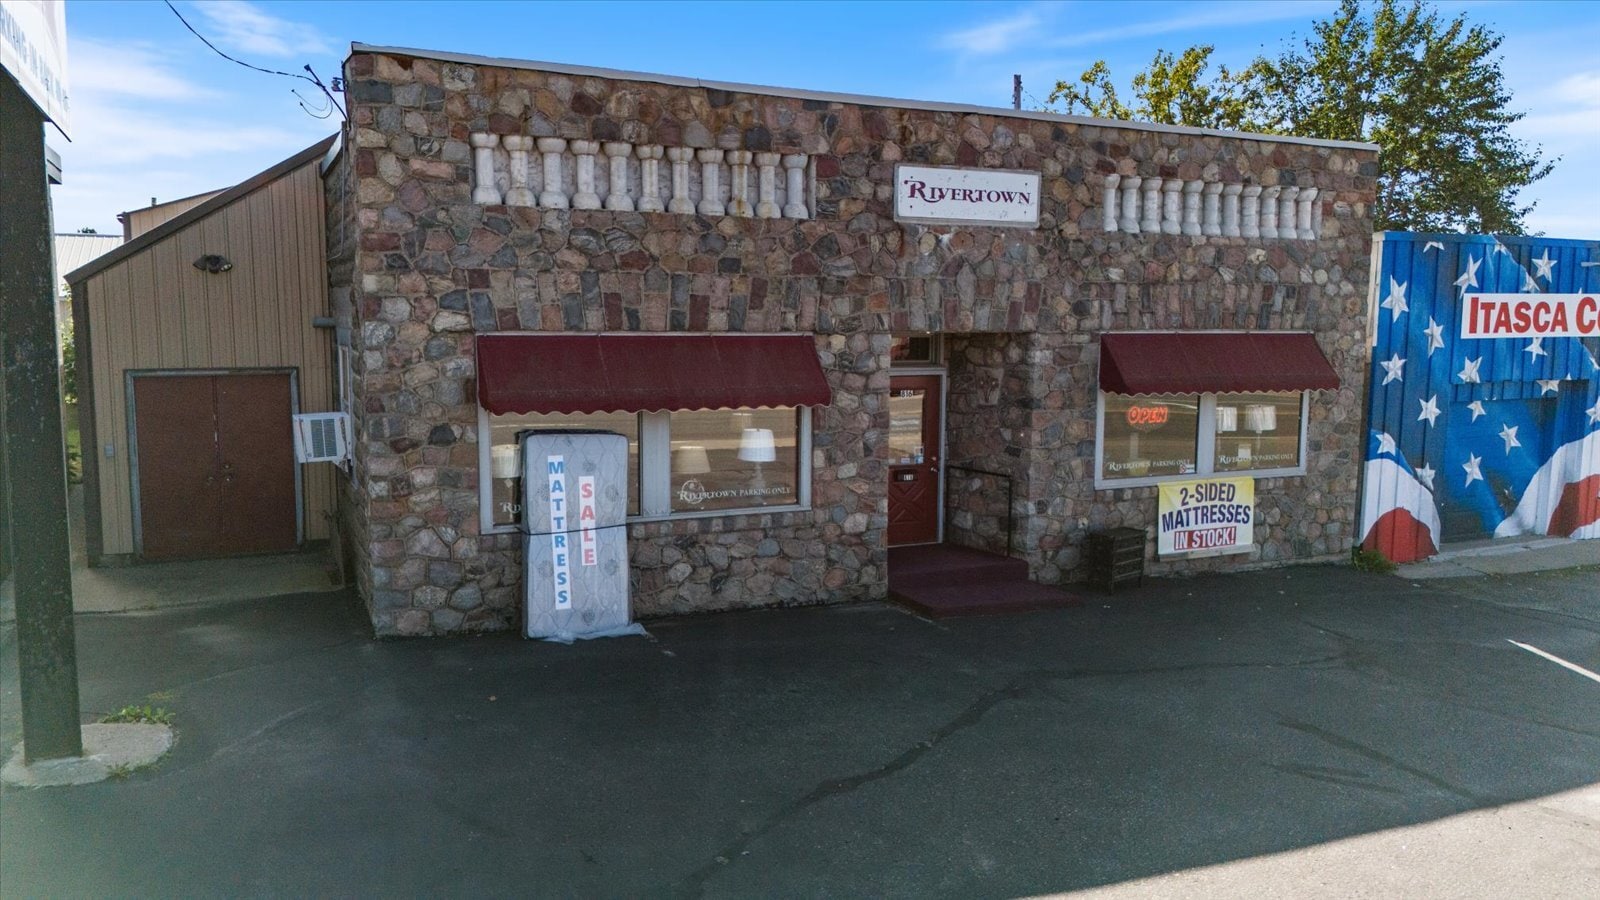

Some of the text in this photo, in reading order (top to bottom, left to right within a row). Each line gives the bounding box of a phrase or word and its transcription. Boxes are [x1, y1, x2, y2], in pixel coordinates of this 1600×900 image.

[904, 179, 1031, 205] RIVERTOWN
[1469, 296, 1600, 334] ITASCA C
[1128, 406, 1169, 424] OPEN
[1107, 462, 1150, 472] RIVERTOWN
[739, 487, 771, 497] PARKING
[771, 486, 792, 495] ONLY
[1180, 482, 1236, 507] 2-SIDED
[580, 482, 596, 564] SALE
[1162, 503, 1251, 533] MATTRESSES
[548, 461, 568, 604] MATTRESS
[1175, 527, 1236, 550] IN STOCK!
